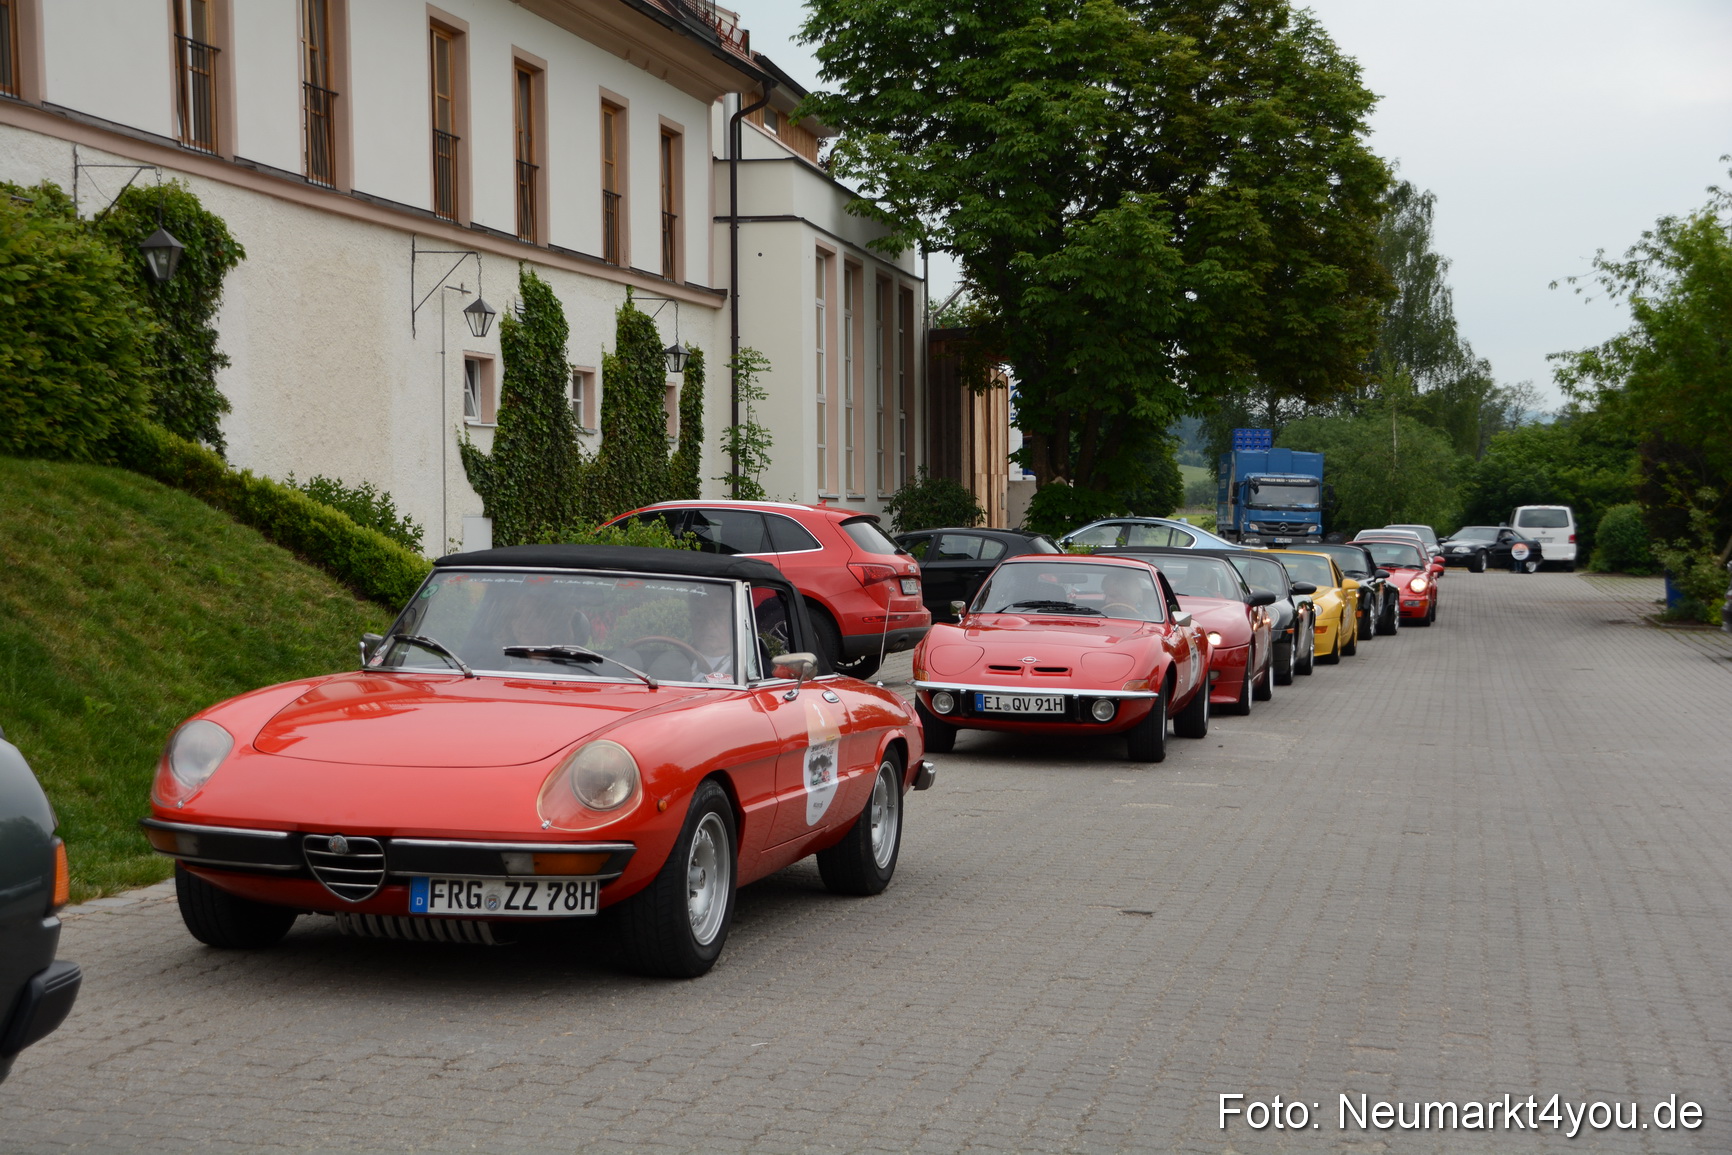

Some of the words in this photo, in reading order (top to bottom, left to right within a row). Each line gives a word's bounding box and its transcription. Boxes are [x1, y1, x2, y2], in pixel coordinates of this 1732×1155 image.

[984, 696, 1002, 710] EI
[1012, 697, 1031, 711] QV
[1035, 698, 1063, 711] 91H
[416, 897, 424, 906] D
[429, 879, 483, 909] FRG
[504, 881, 539, 911] ZZ
[547, 881, 597, 911] 78H
